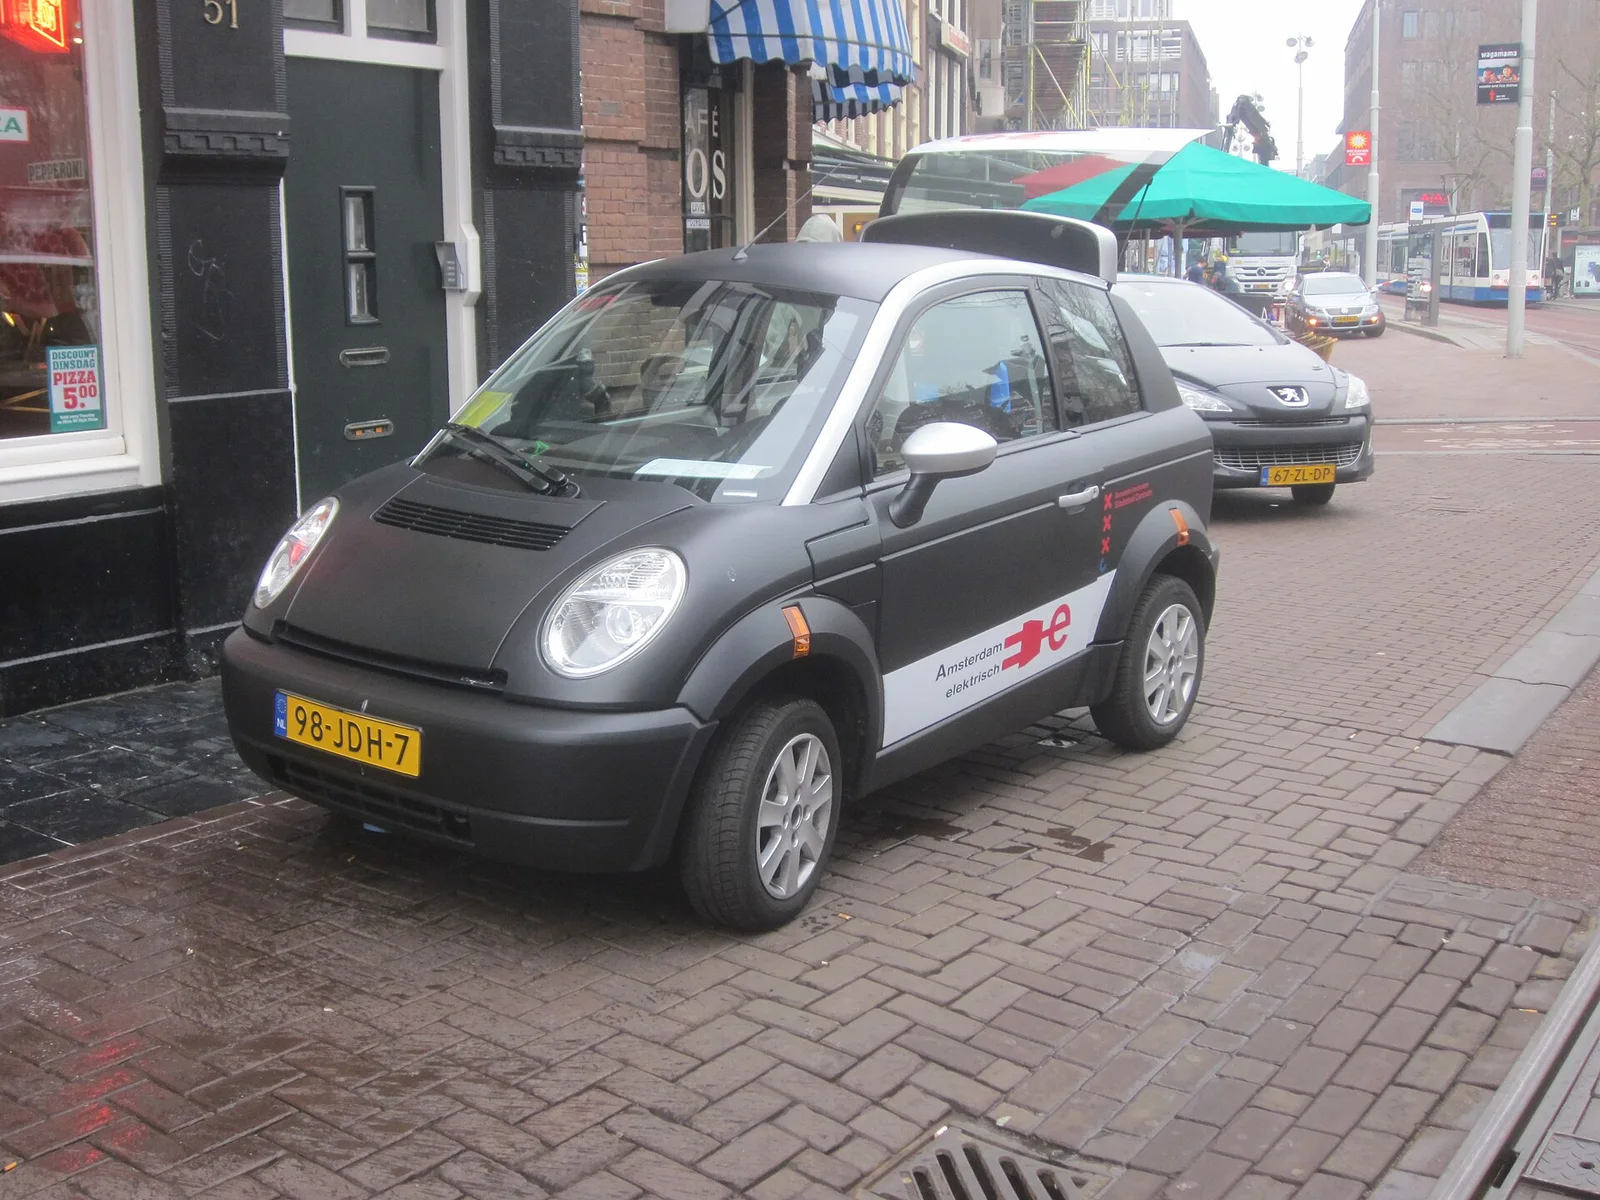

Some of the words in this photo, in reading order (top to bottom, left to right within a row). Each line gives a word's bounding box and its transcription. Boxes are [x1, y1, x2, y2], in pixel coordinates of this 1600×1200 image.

[203, 0, 239, 29] 51
[1480, 50, 1518, 59] wagamama
[0, 116, 23, 133] A
[28, 160, 84, 182] PEPPERONI
[52, 349, 96, 360] DISCOUNT
[52, 359, 95, 370] DINSDAG
[53, 370, 97, 385] PIZZA
[1273, 467, 1331, 482] 67-ZL-DP
[935, 641, 1003, 681] Amsterdam
[945, 663, 1000, 698] elektrisch
[276, 717, 286, 730] NL
[294, 705, 410, 766] 98-JDH-7
